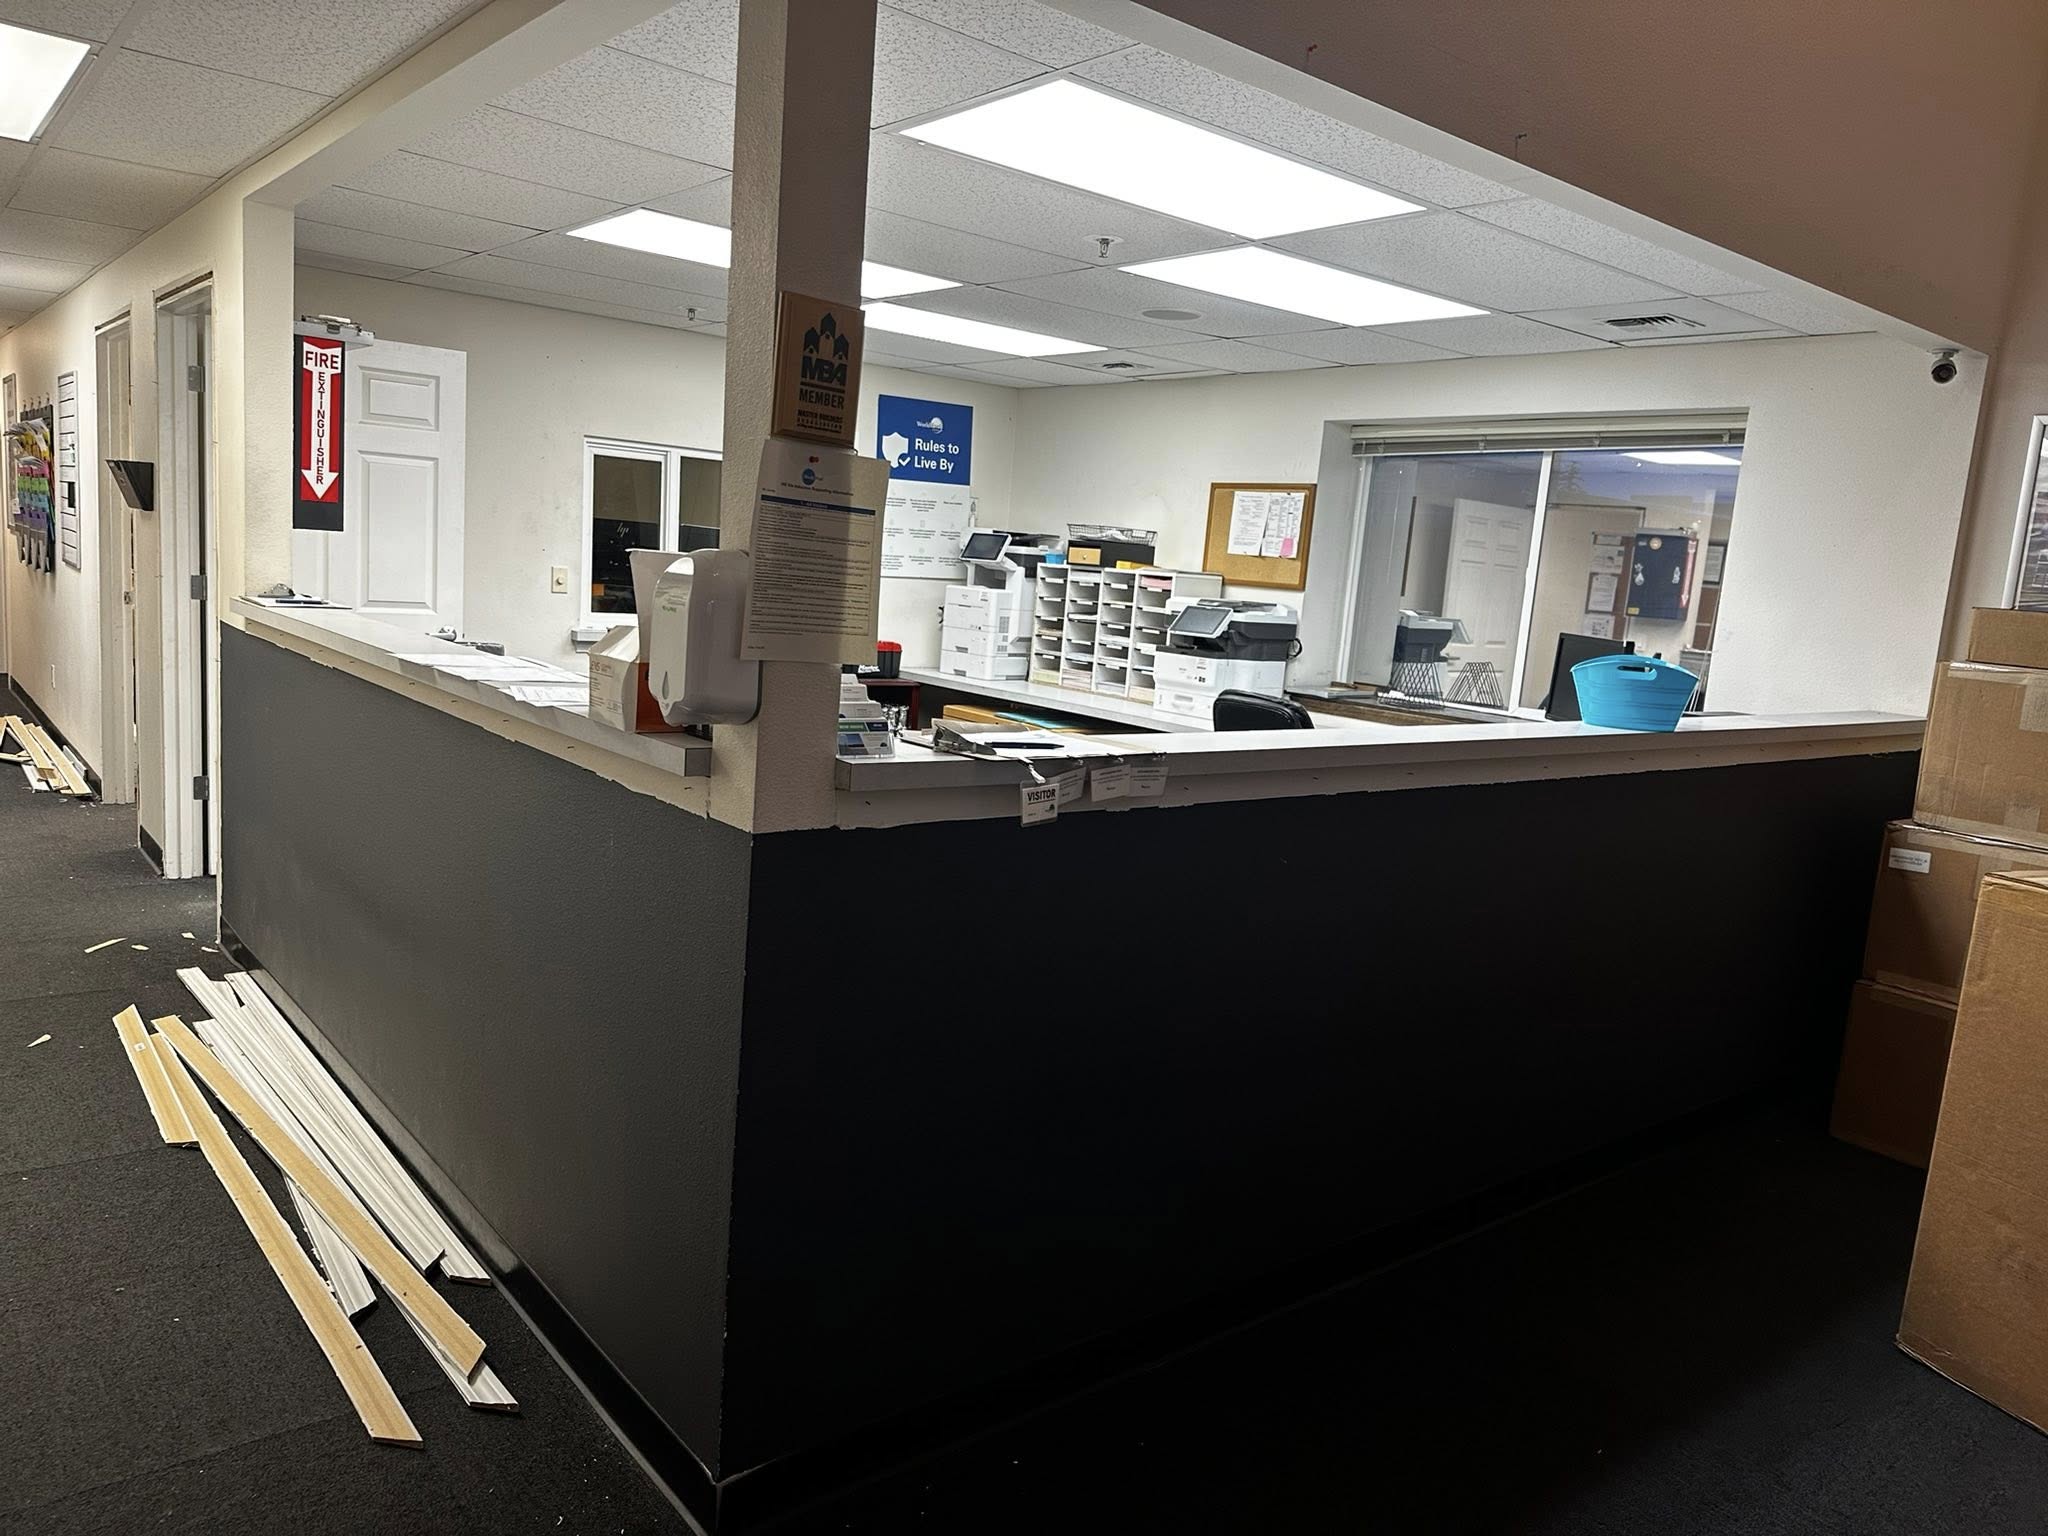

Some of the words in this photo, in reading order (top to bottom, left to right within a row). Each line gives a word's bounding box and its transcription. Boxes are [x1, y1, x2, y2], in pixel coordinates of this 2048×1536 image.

[305, 351, 339, 370] FIRE
[801, 356, 848, 387] MBA
[799, 388, 845, 411] MEMBER
[316, 372, 325, 485] EXTINGUISHER
[914, 438, 946, 453] Rules
[947, 443, 960, 455] to
[914, 456, 937, 470] Live
[939, 459, 954, 473] By
[1027, 788, 1056, 802] VISITOR
